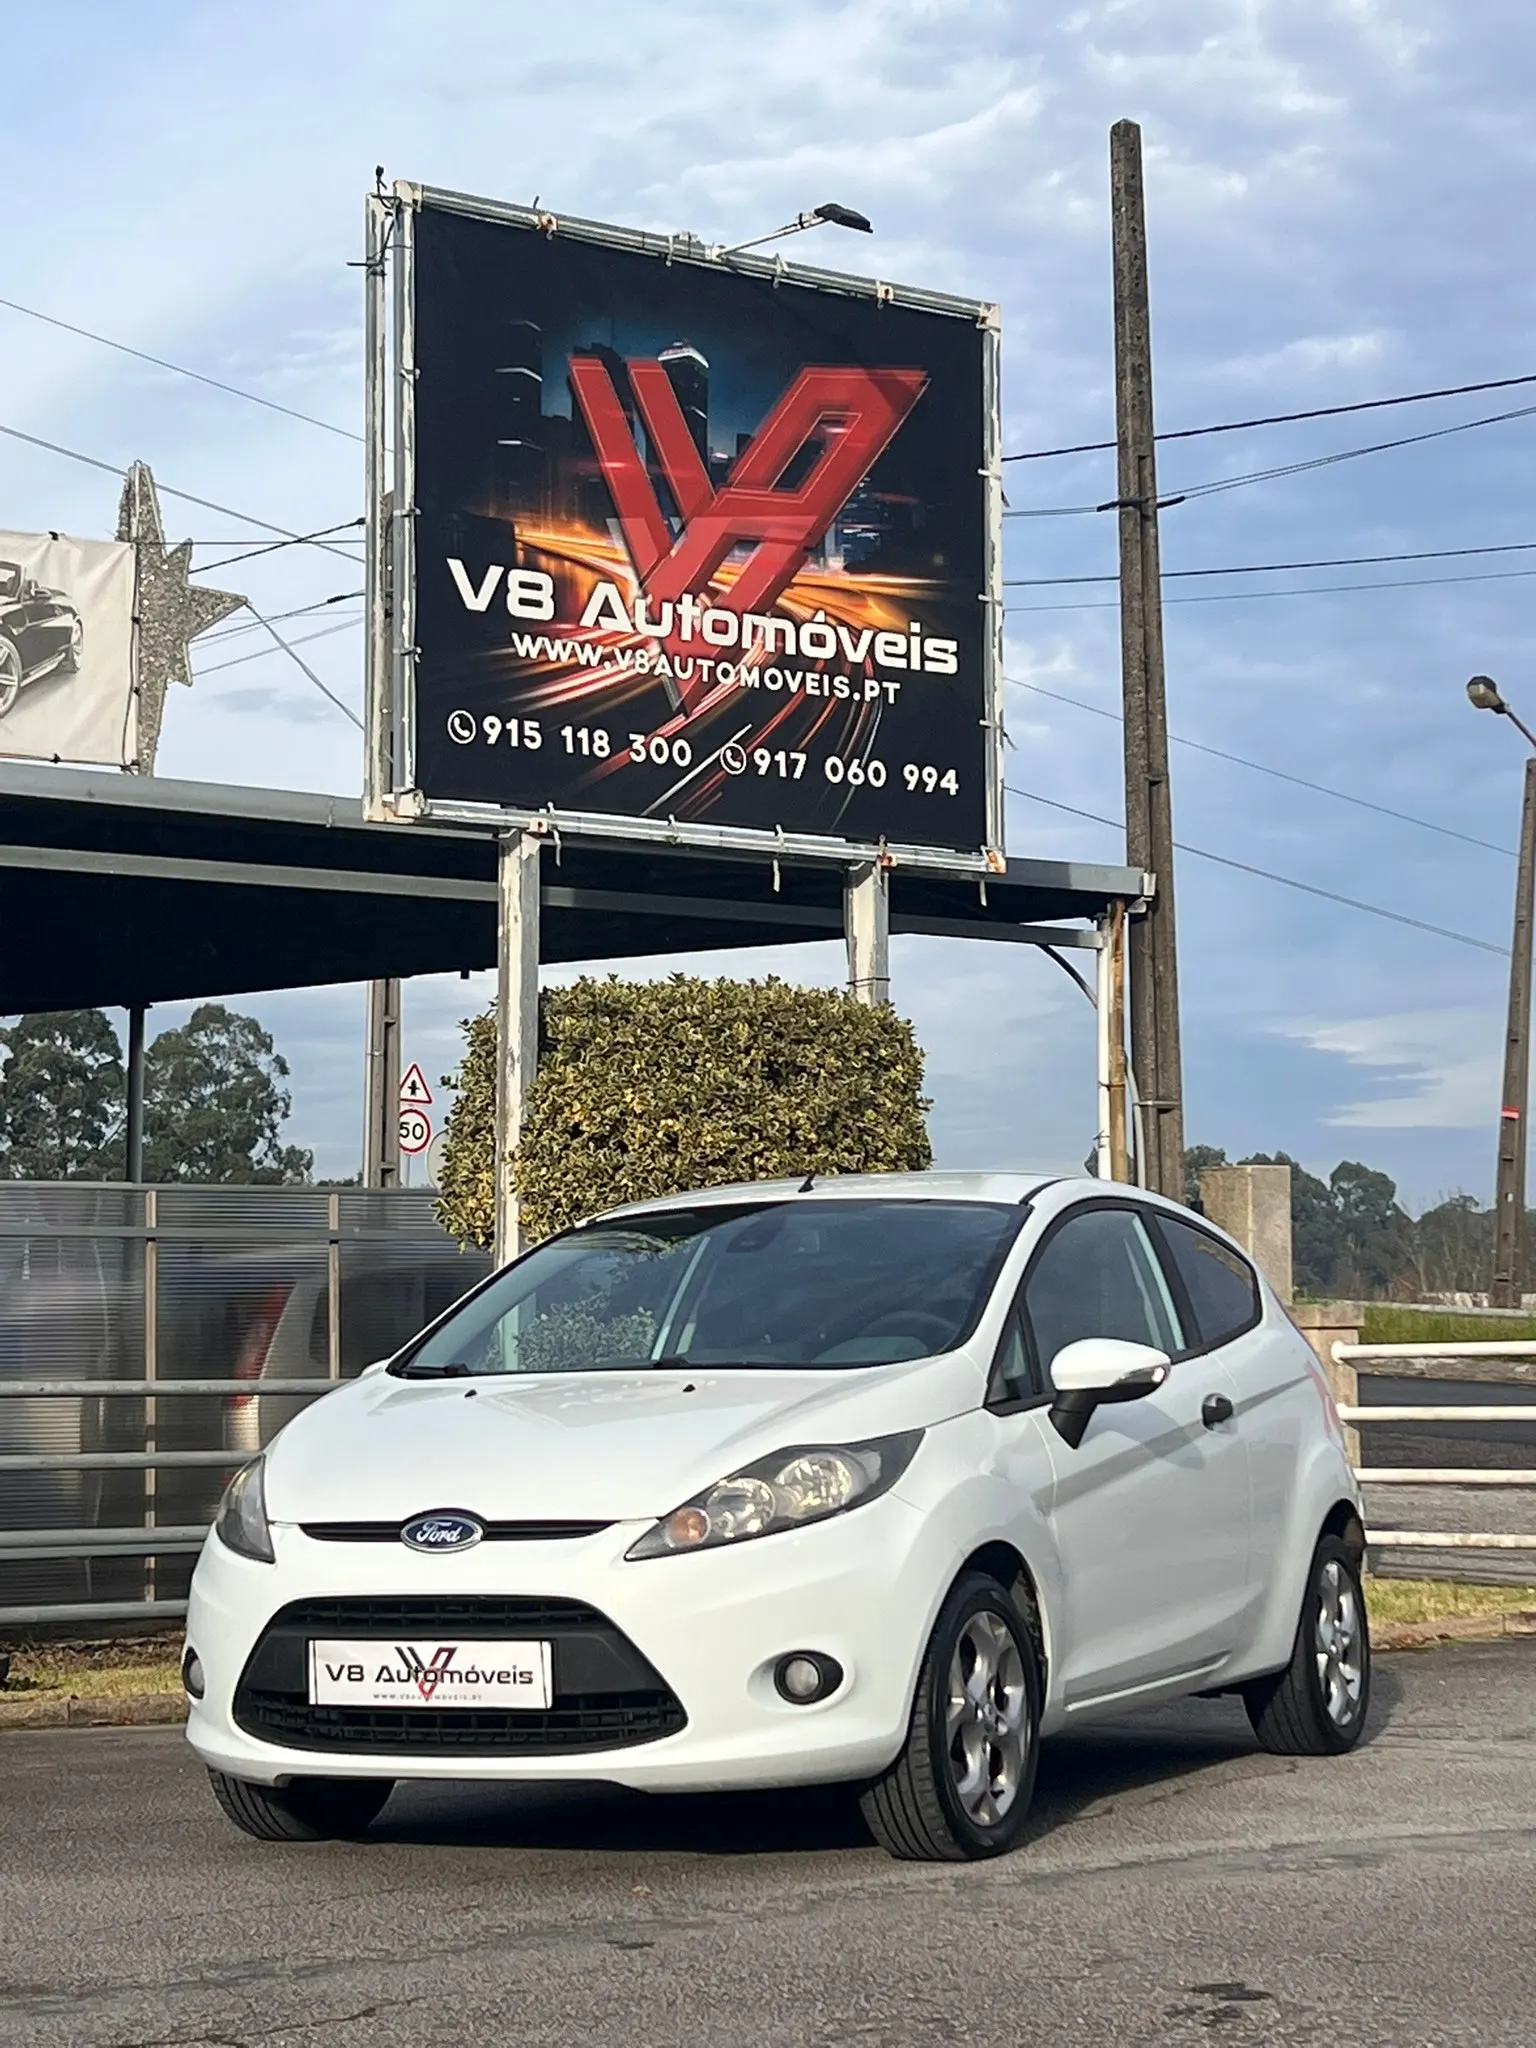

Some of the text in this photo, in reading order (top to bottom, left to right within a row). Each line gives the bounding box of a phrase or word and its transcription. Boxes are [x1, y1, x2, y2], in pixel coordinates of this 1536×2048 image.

[446, 557, 959, 675] V8 Automóveis
[482, 715, 960, 796] 915 118 300 917 060 994
[400, 1121, 424, 1140] 50
[416, 1521, 461, 1543] Ford
[325, 1664, 534, 1685] V8 Automóveis
